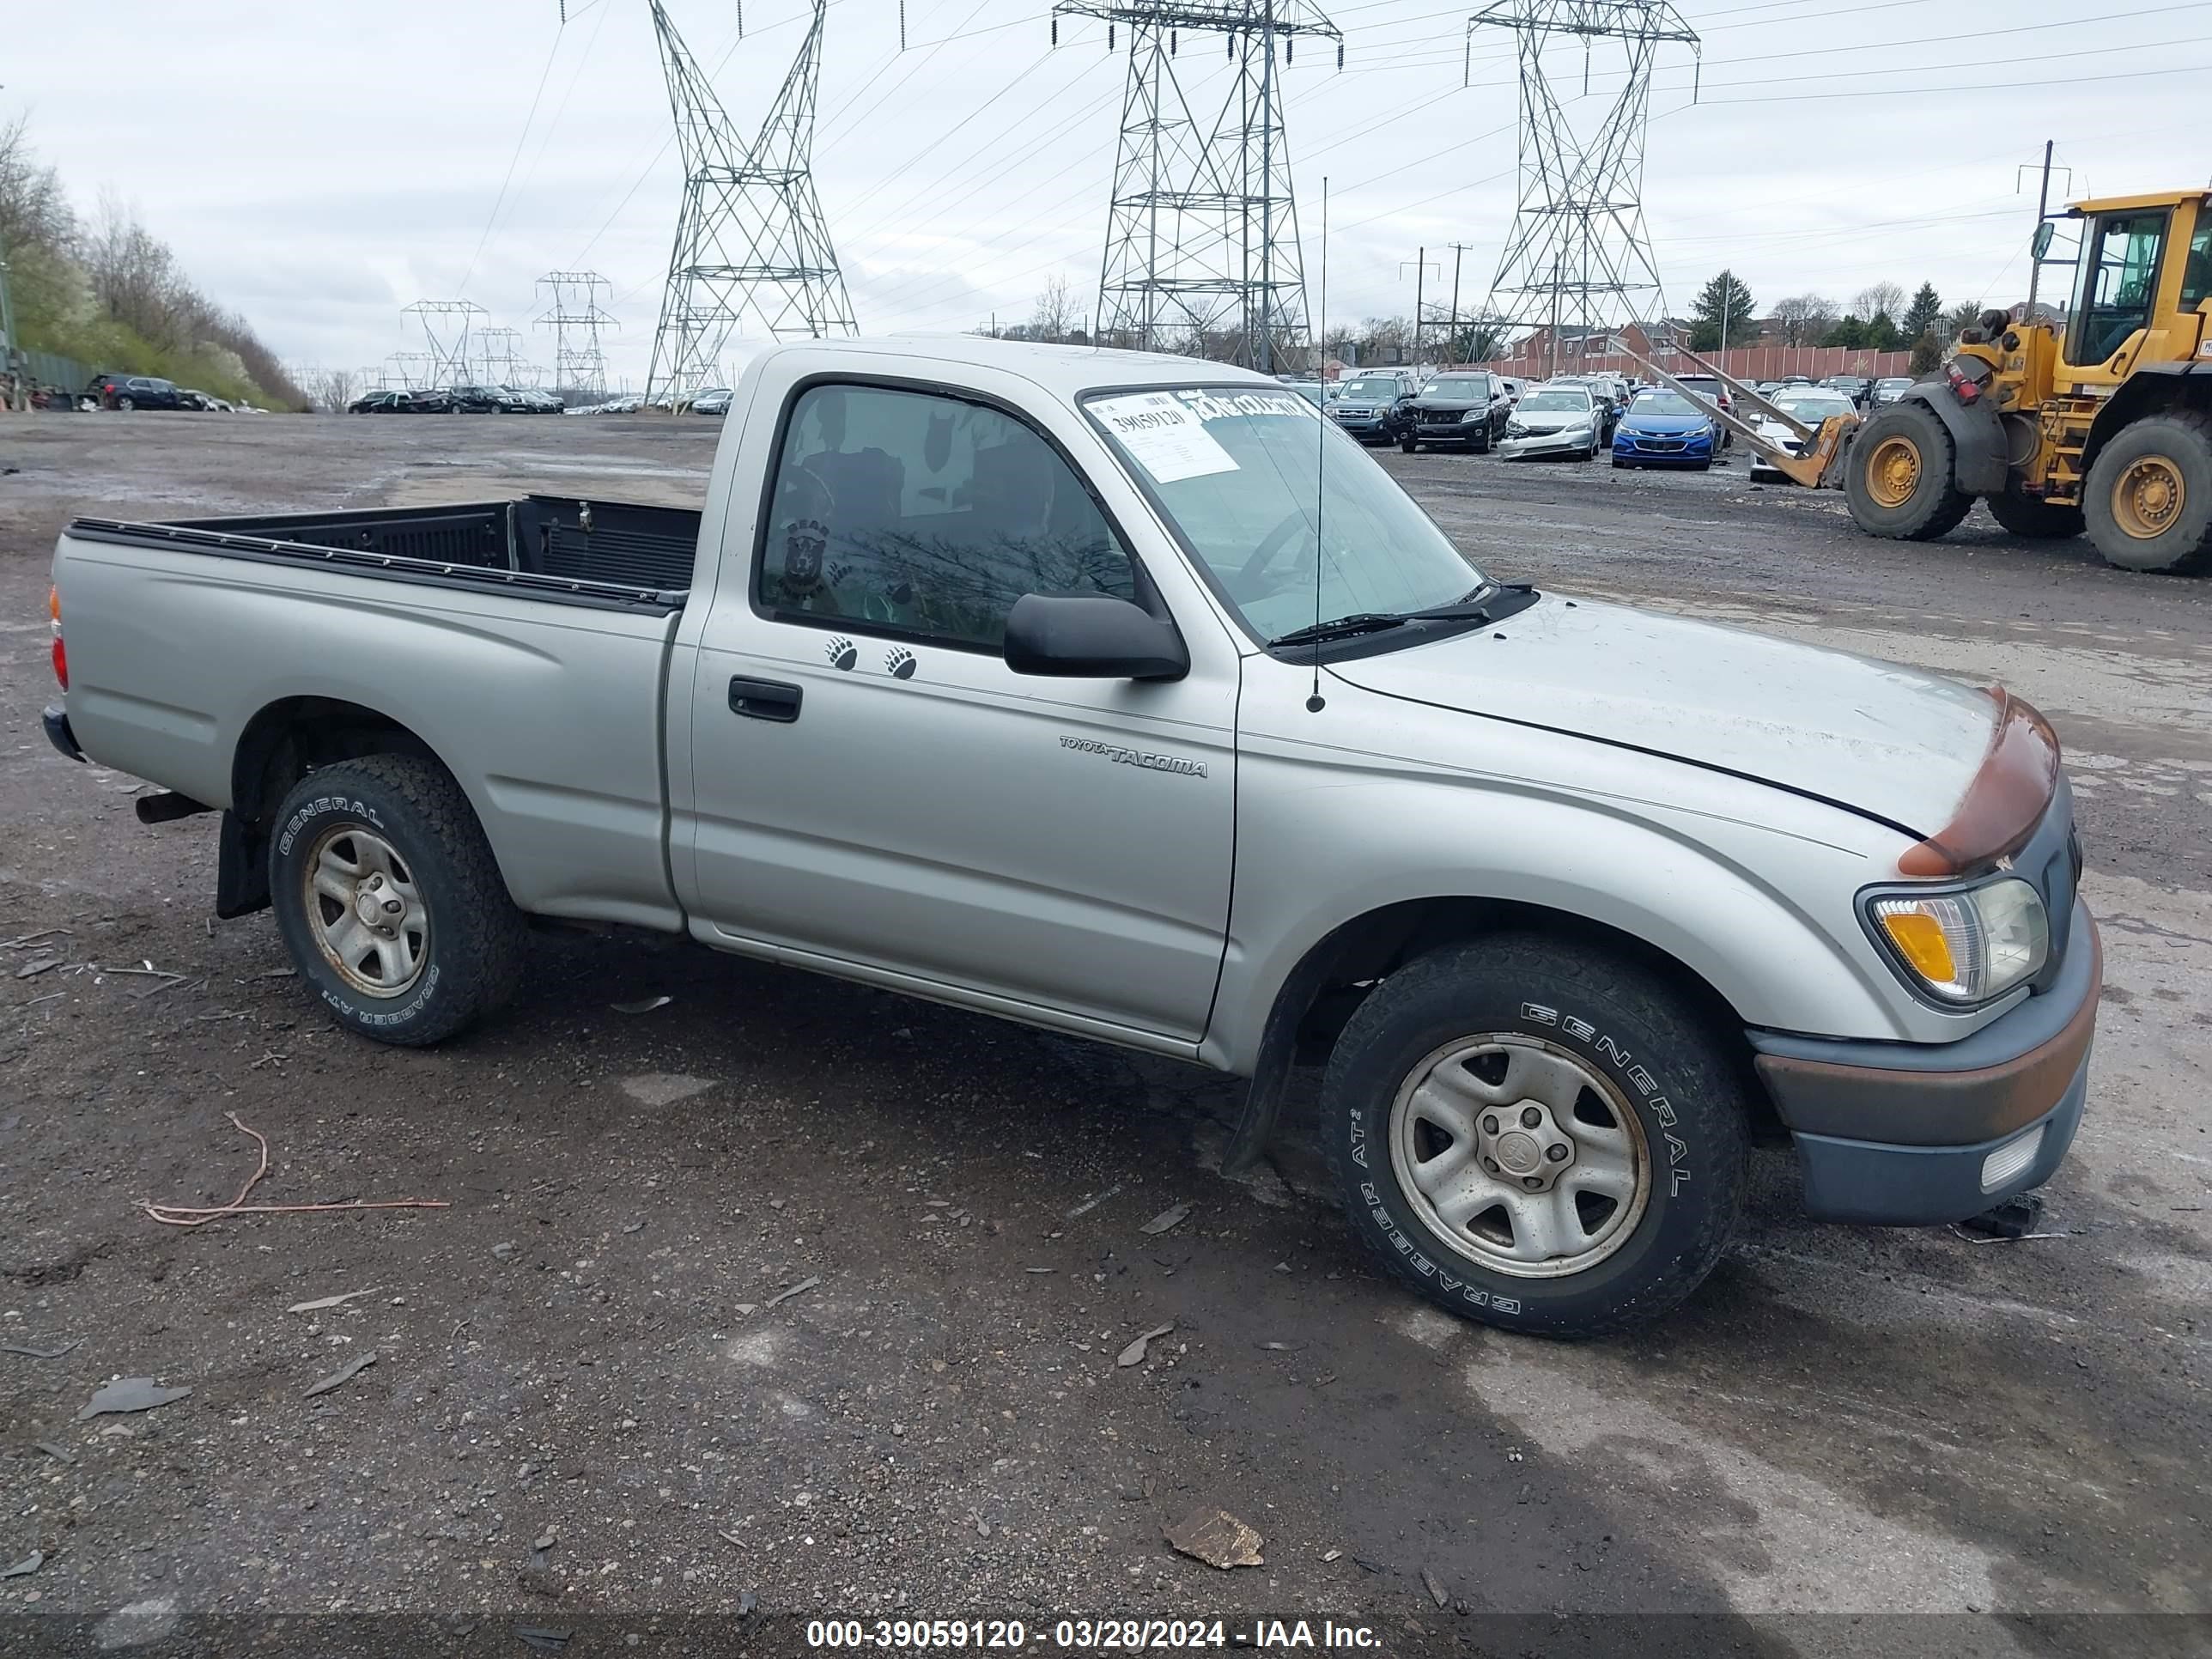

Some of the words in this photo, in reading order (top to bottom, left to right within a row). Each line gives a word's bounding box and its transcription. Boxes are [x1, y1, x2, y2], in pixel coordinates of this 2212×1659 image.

[1113, 410, 1186, 433] 39059120
[1187, 397, 1243, 422] BONE
[1060, 735, 1108, 755] TOYOTA
[1108, 746, 1208, 778] TACOMA
[279, 797, 384, 855] GENERAL
[359, 964, 440, 1025] GRABBER
[1520, 1001, 1691, 1197] GENERAL
[1360, 1182, 1521, 1316] GRABBER
